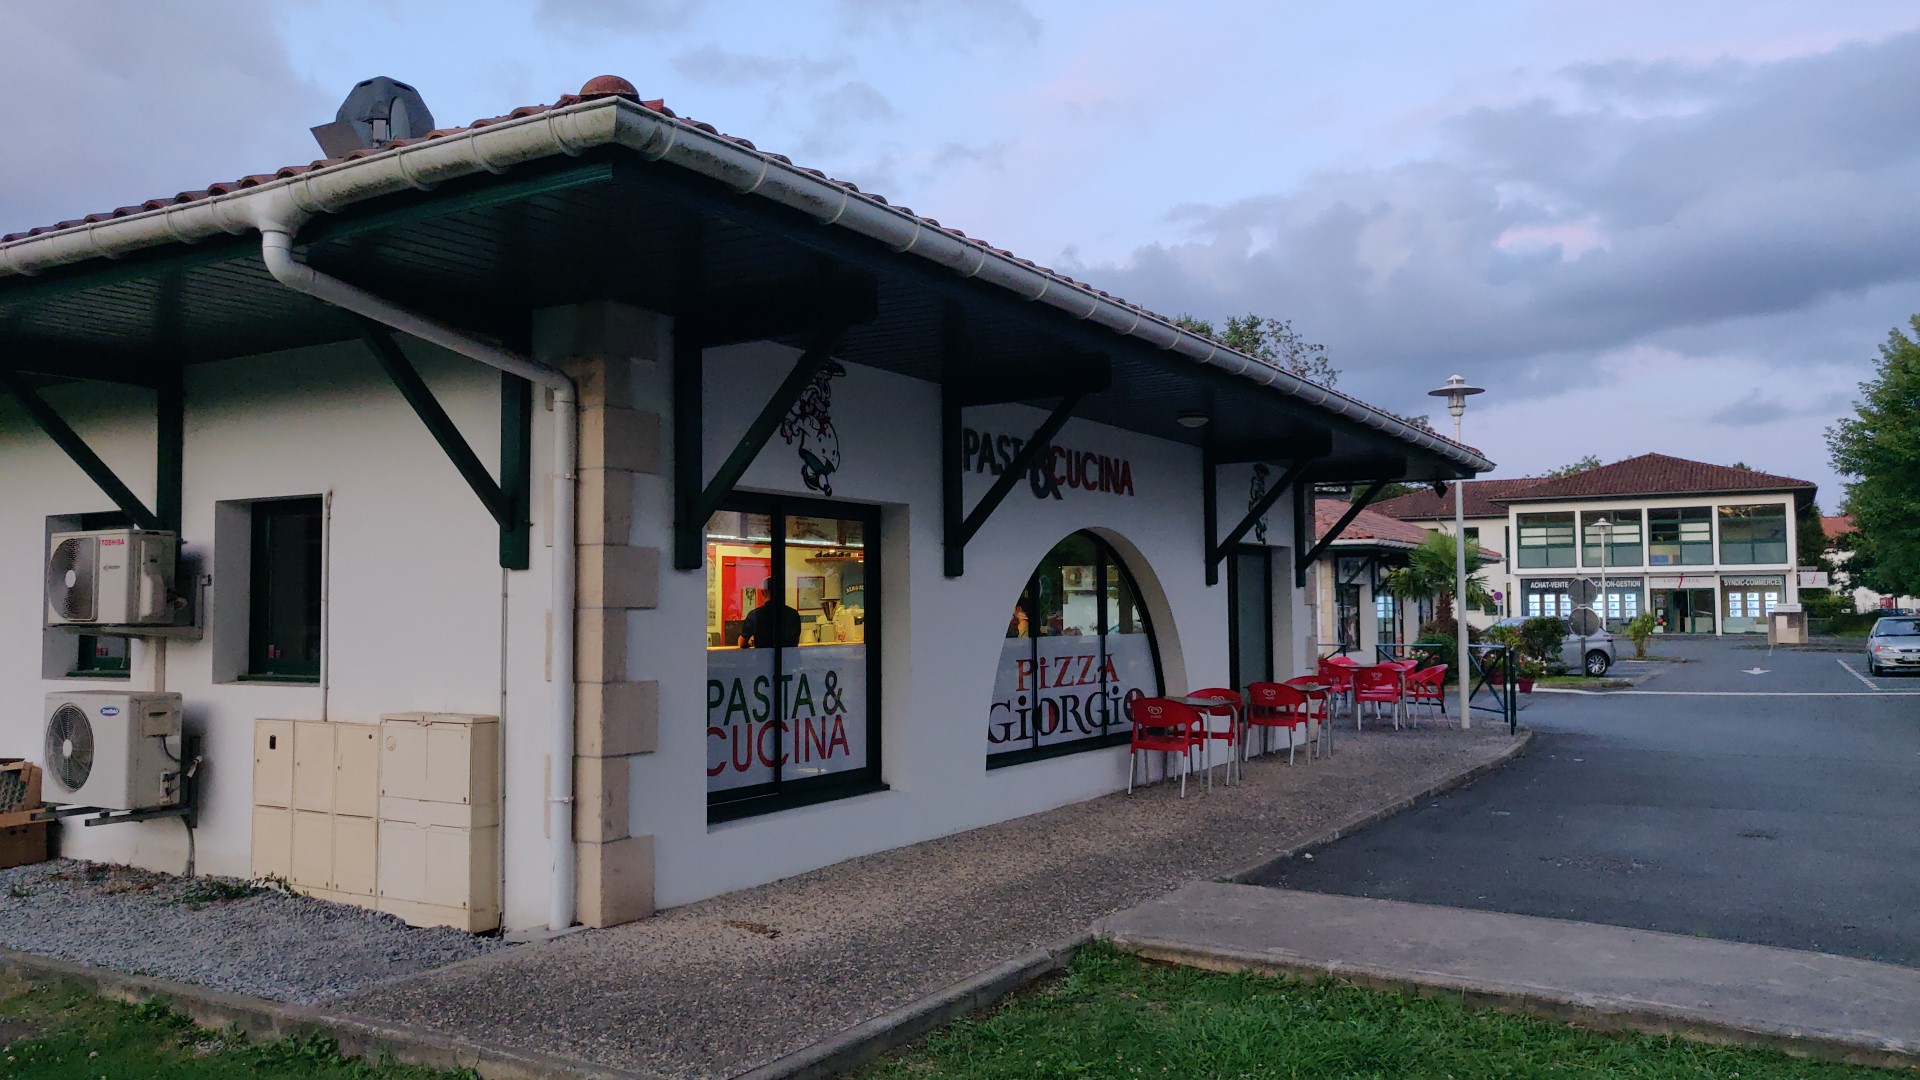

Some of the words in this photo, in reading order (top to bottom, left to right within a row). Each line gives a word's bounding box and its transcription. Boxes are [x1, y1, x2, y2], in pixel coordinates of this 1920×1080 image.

[963, 427, 1028, 480] PAST
[1050, 445, 1134, 496] CUCINA
[1530, 581, 1569, 589] ACHAT-VENTE
[707, 673, 815, 727] PASTA
[823, 670, 848, 715] &
[707, 715, 850, 777] CUCINA
